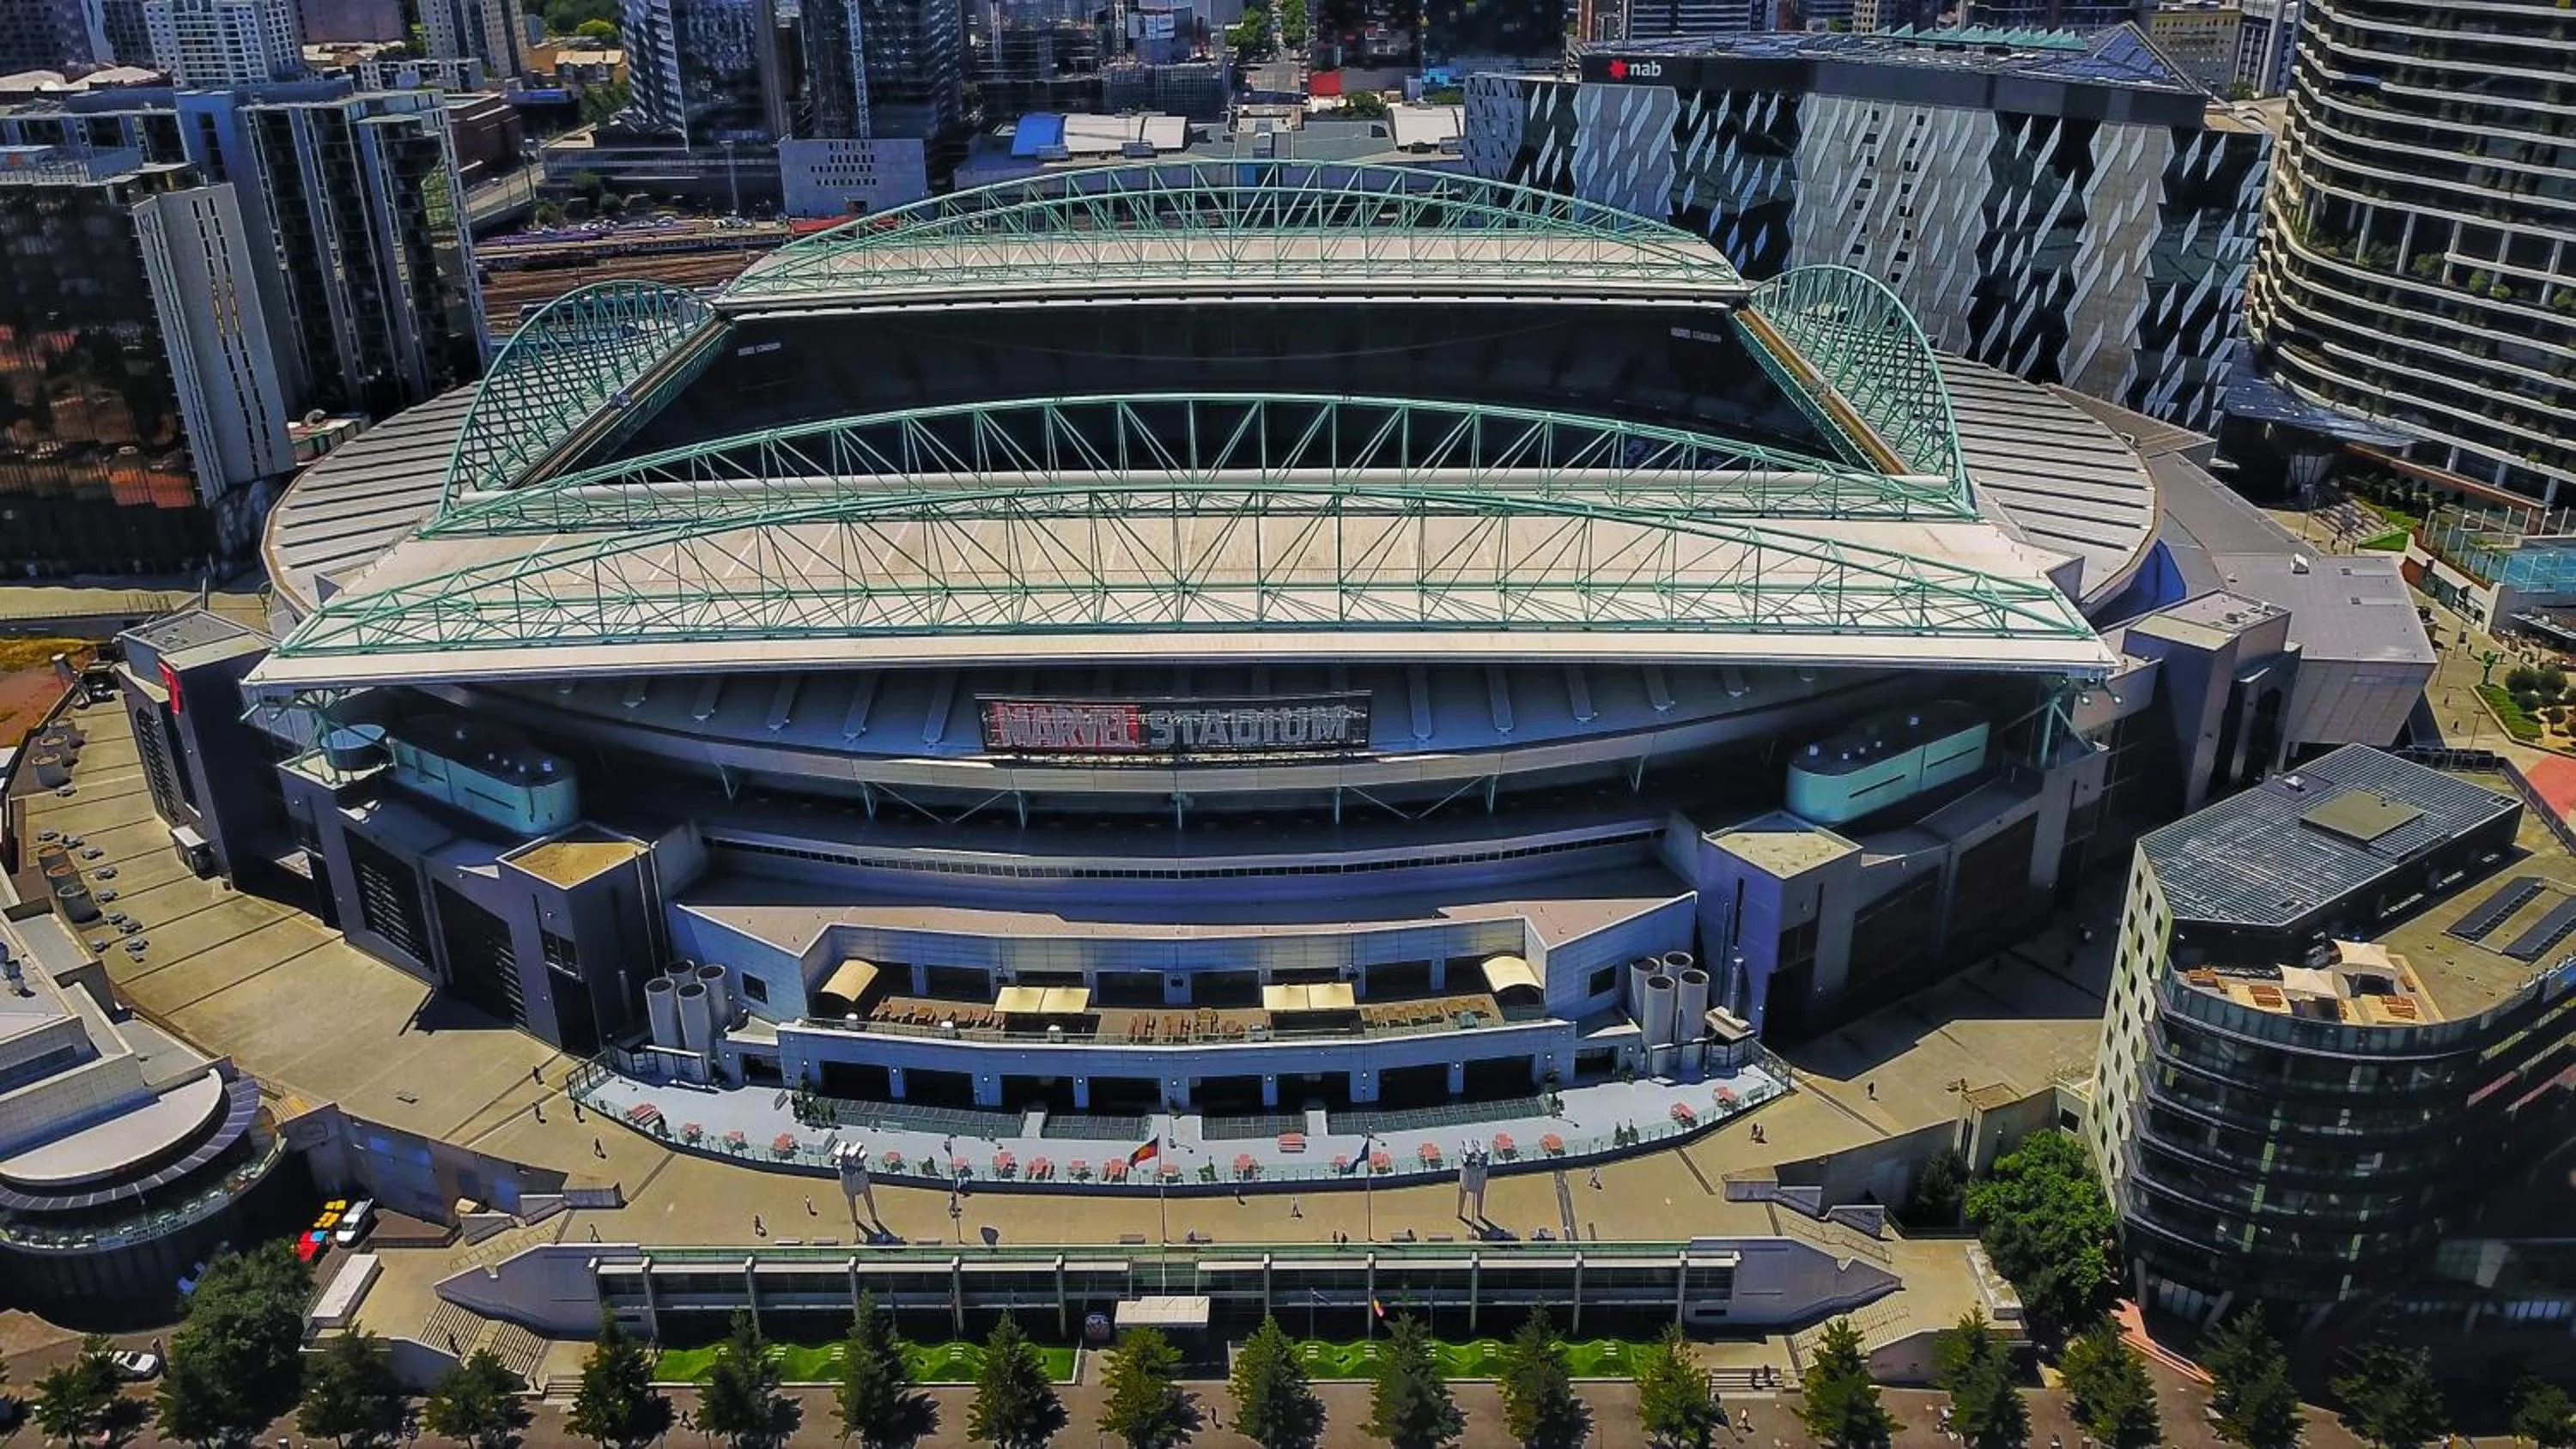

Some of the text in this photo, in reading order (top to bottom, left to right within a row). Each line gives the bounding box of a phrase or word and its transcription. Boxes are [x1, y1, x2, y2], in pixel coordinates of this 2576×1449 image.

[1630, 60, 1662, 76] nab
[996, 704, 1348, 747] MARVEL STADIUM
